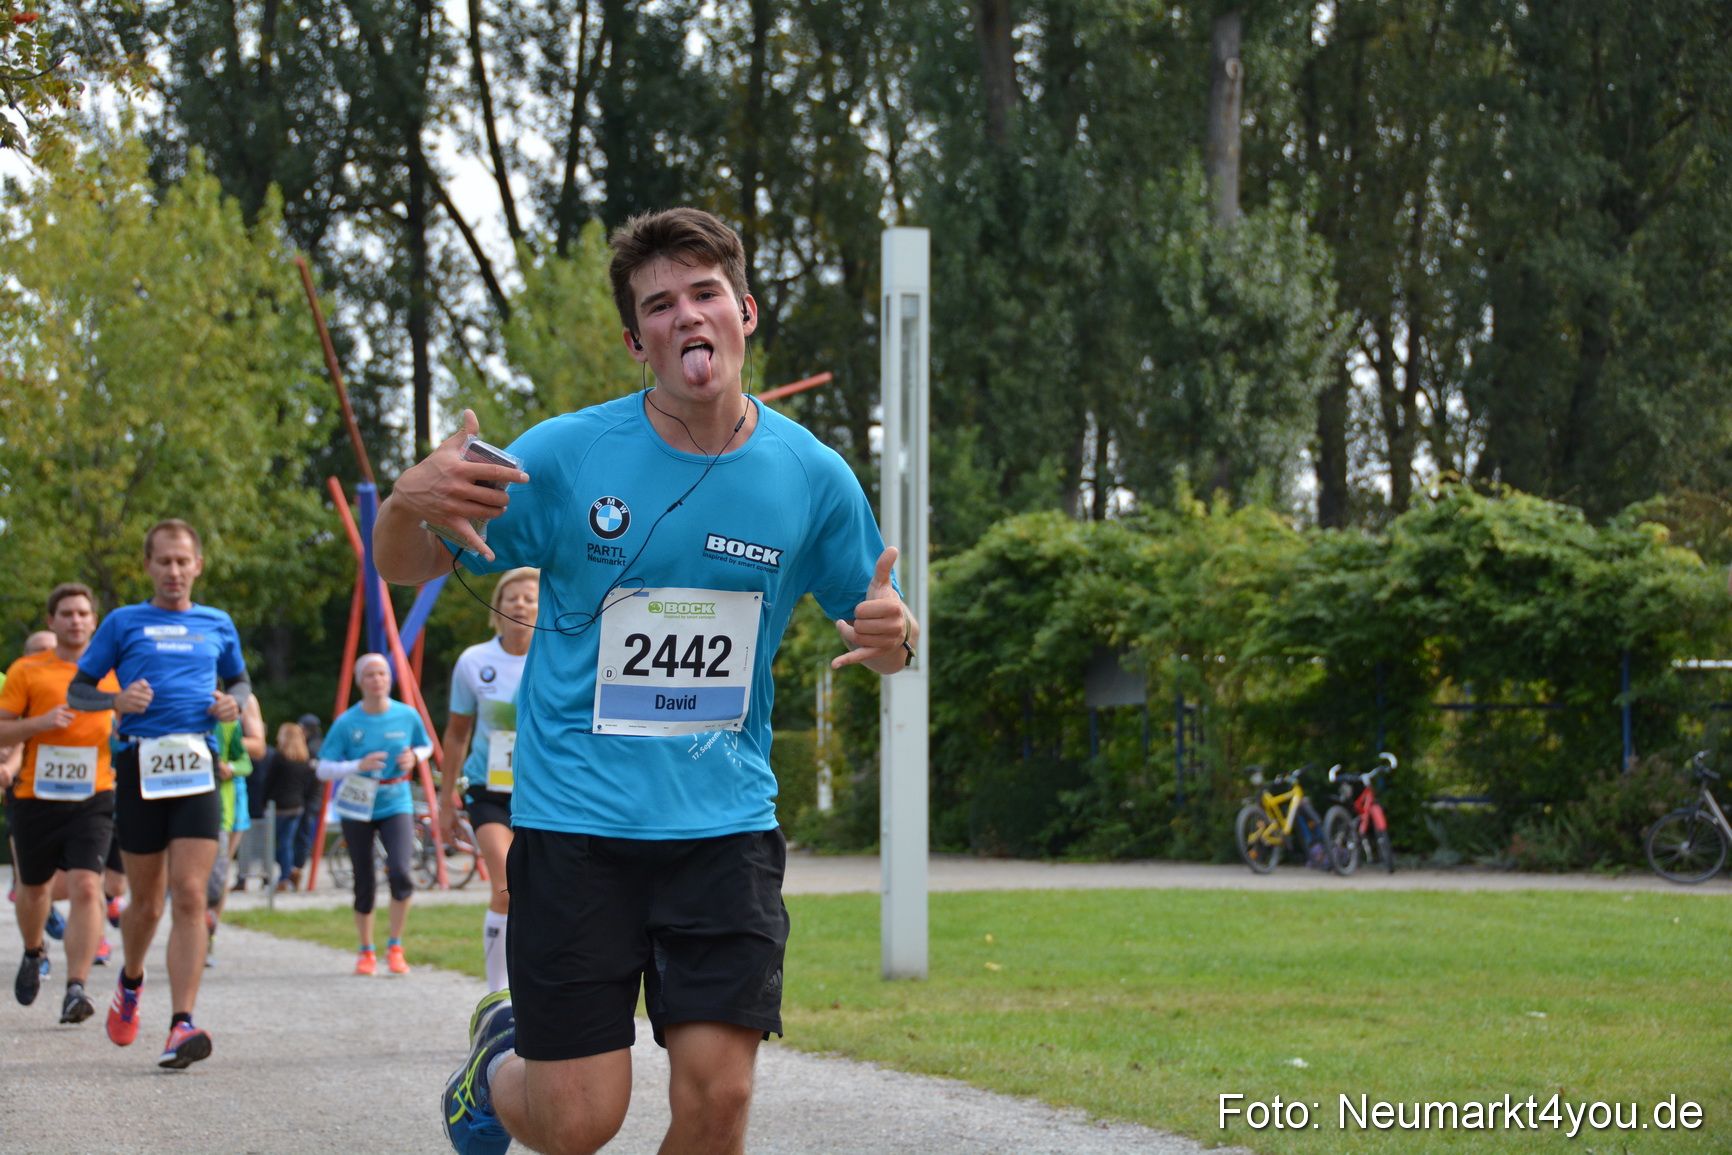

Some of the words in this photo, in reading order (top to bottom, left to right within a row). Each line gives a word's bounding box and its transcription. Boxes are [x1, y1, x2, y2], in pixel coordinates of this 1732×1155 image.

[594, 497, 628, 514] BMW
[587, 543, 627, 558] PARTL
[705, 534, 782, 566] BOCK
[587, 554, 627, 567] Neumarkt
[703, 551, 728, 563] inspired
[729, 557, 736, 565] by
[738, 560, 756, 569] smart
[757, 565, 779, 574] concepts
[665, 602, 715, 614] BOCK
[622, 633, 732, 678] 2442
[655, 694, 697, 710] David
[692, 751, 702, 761] 17.
[699, 731, 722, 754] Septem
[44, 761, 87, 779] 2120
[150, 752, 201, 774] 2412
